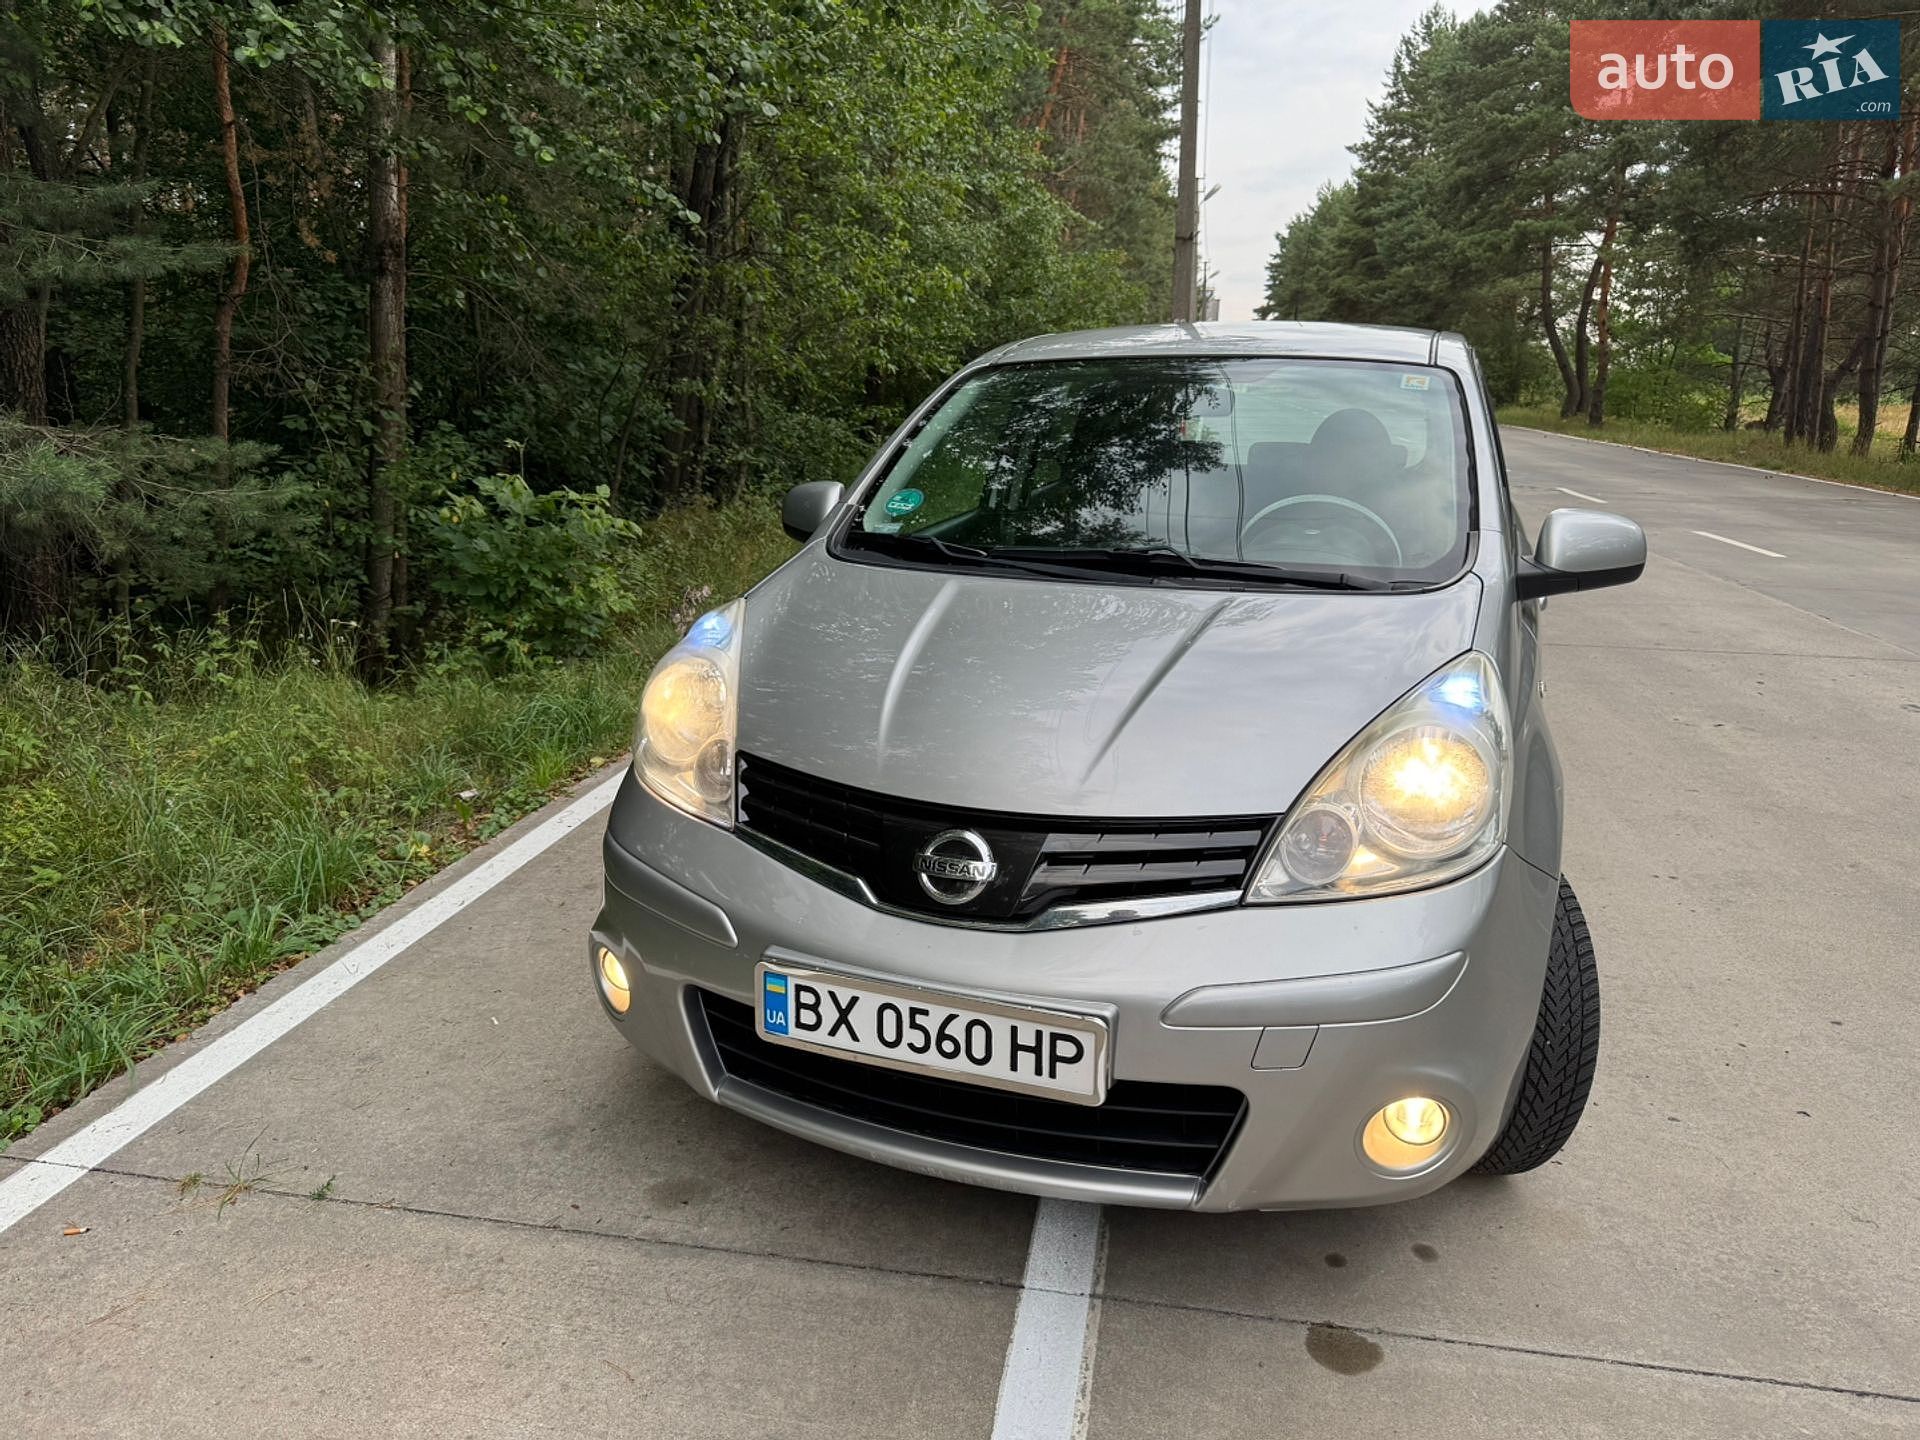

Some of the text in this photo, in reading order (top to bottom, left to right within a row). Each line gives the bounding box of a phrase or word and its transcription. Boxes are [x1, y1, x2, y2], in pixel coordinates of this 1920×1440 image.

[920, 857, 987, 878] NISSAN
[766, 1008, 786, 1027] UA
[794, 984, 1085, 1079] BX 0560 HP
